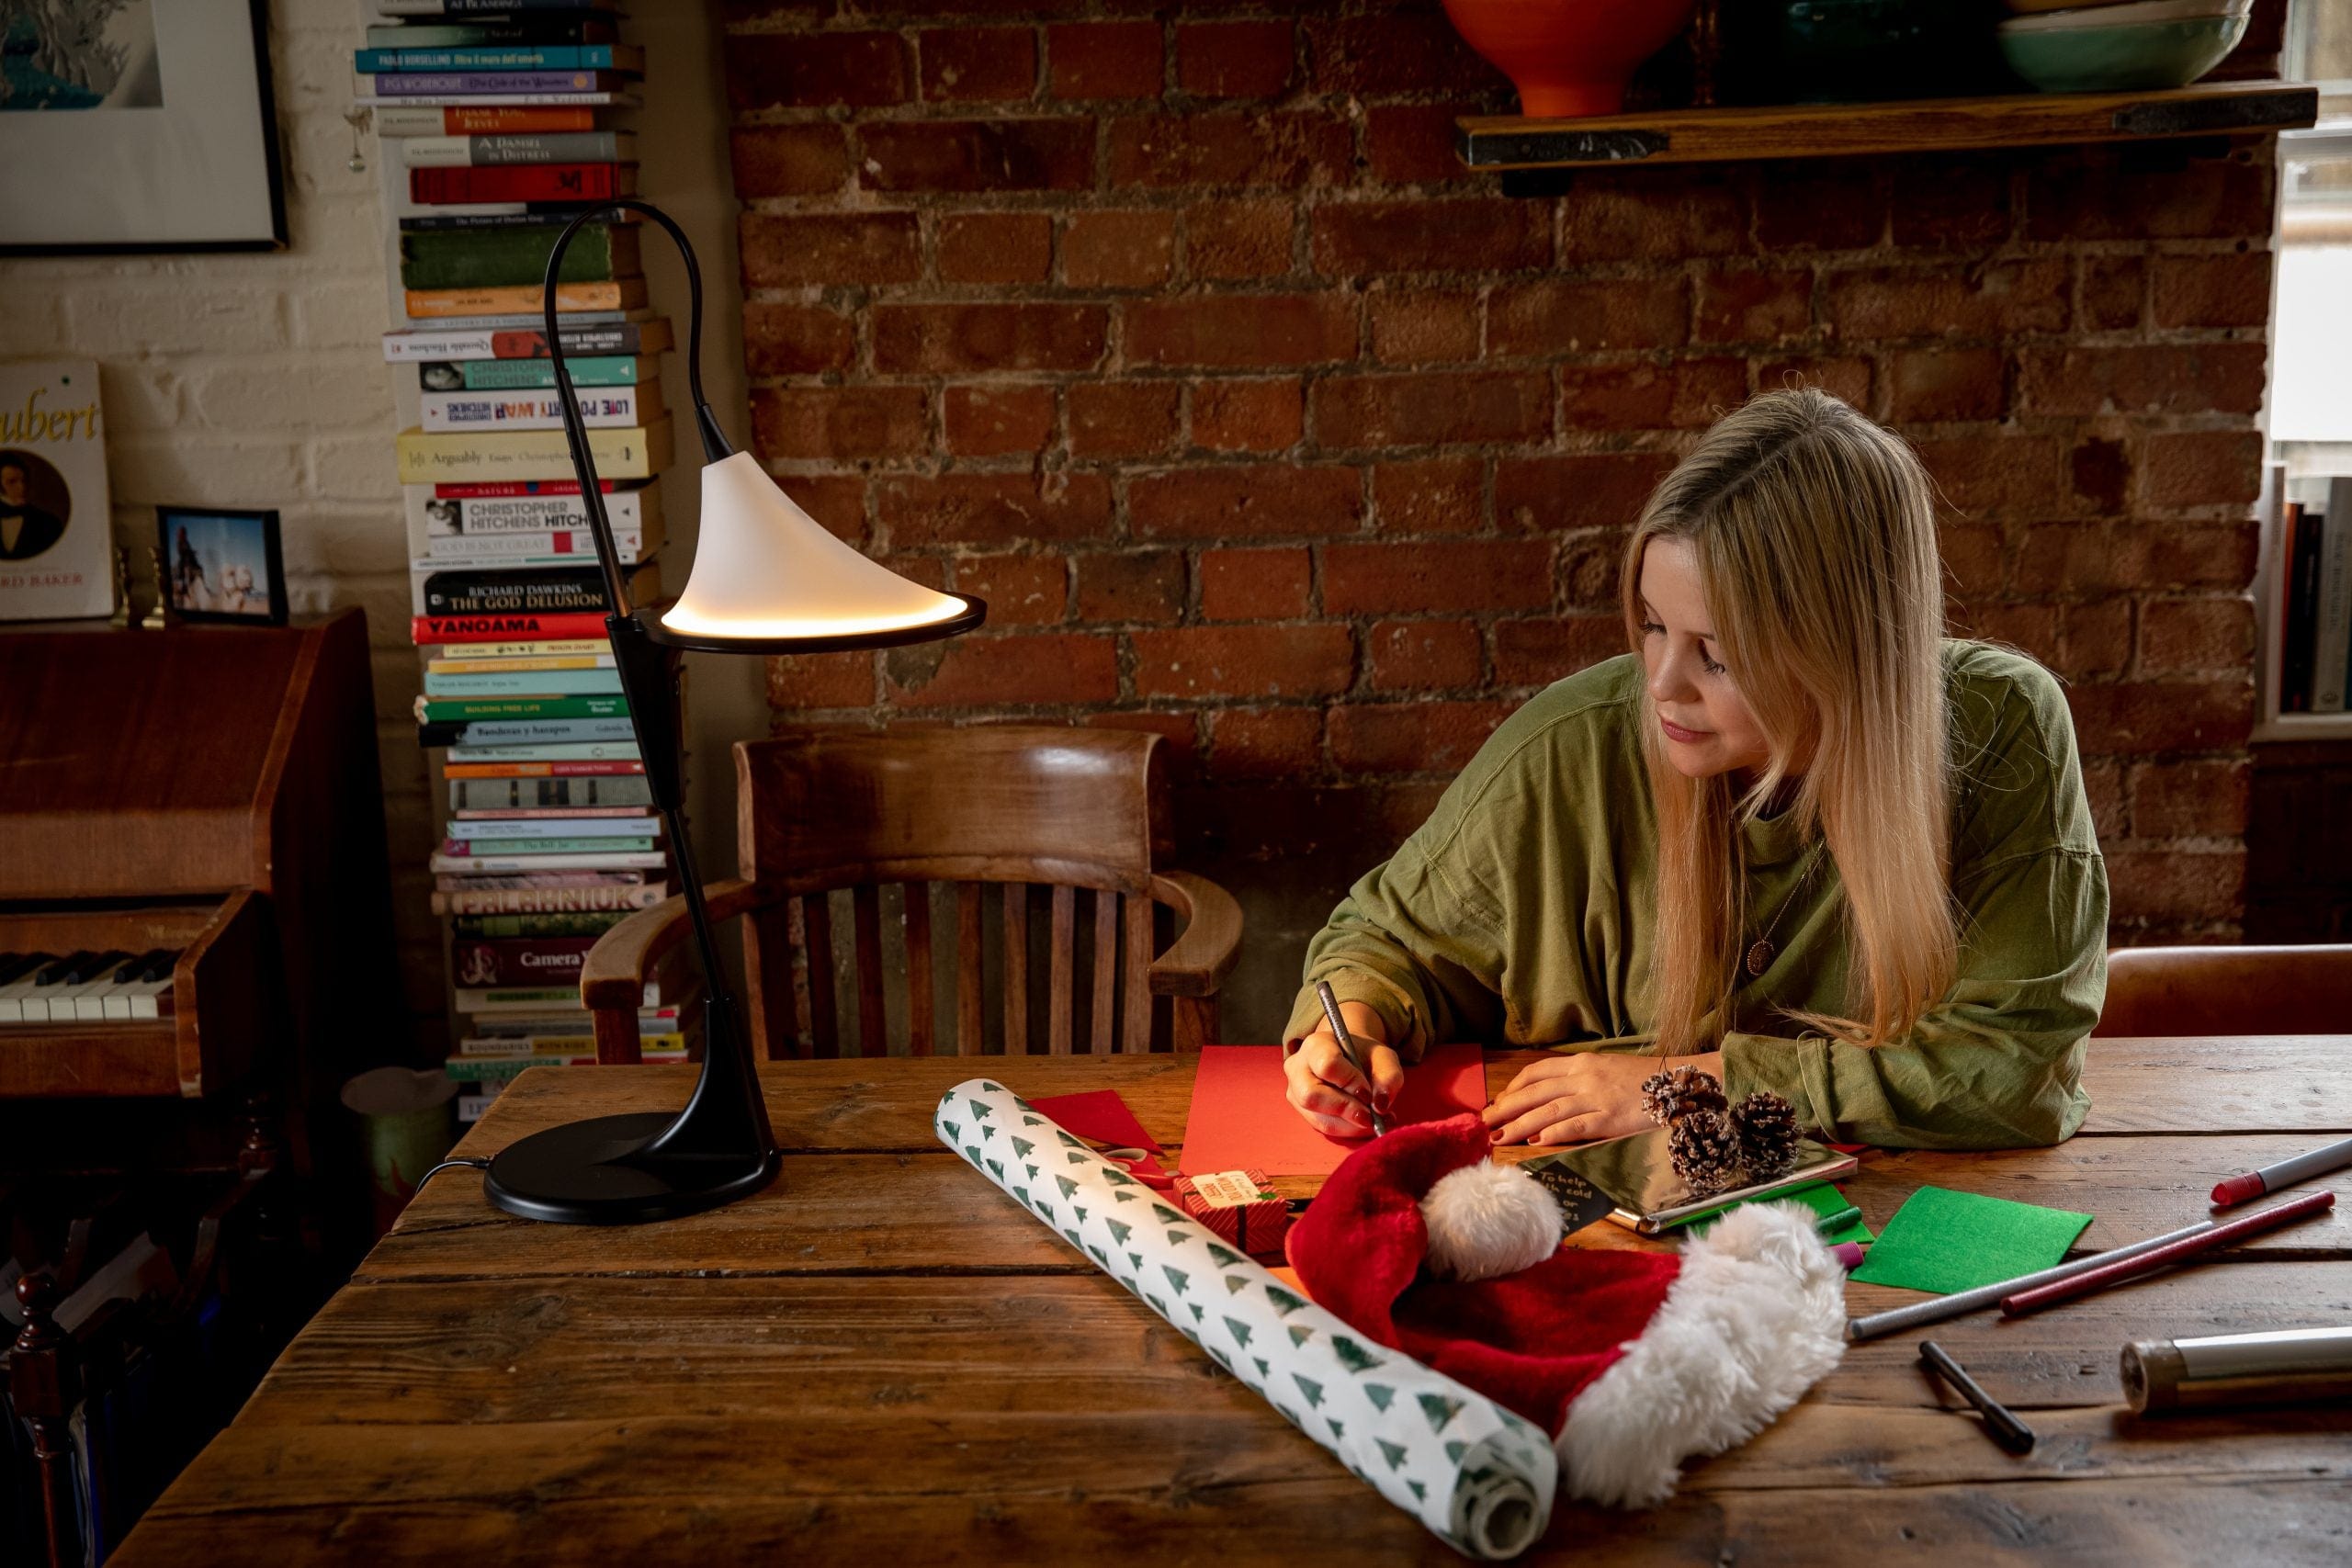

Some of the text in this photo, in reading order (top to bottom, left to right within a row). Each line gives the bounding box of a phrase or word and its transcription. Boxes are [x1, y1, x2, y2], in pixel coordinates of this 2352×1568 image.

[479, 136, 541, 149] A DAMSEL
[471, 359, 553, 374] CHRISTOPH
[472, 375, 538, 387] HITCHENS
[0, 387, 98, 443] ubert
[431, 449, 481, 467] Arguably
[469, 502, 568, 517] CHRISTOPHER
[470, 514, 541, 531] HITCHENS
[469, 582, 583, 597] RICHARD DAWKINS
[450, 593, 605, 612] THE GOD DELUSION
[461, 885, 636, 914] PALAHNIUK
[519, 952, 581, 967] Camera
[1540, 1171, 1588, 1189] To help
[1566, 1188, 1592, 1201] cold
